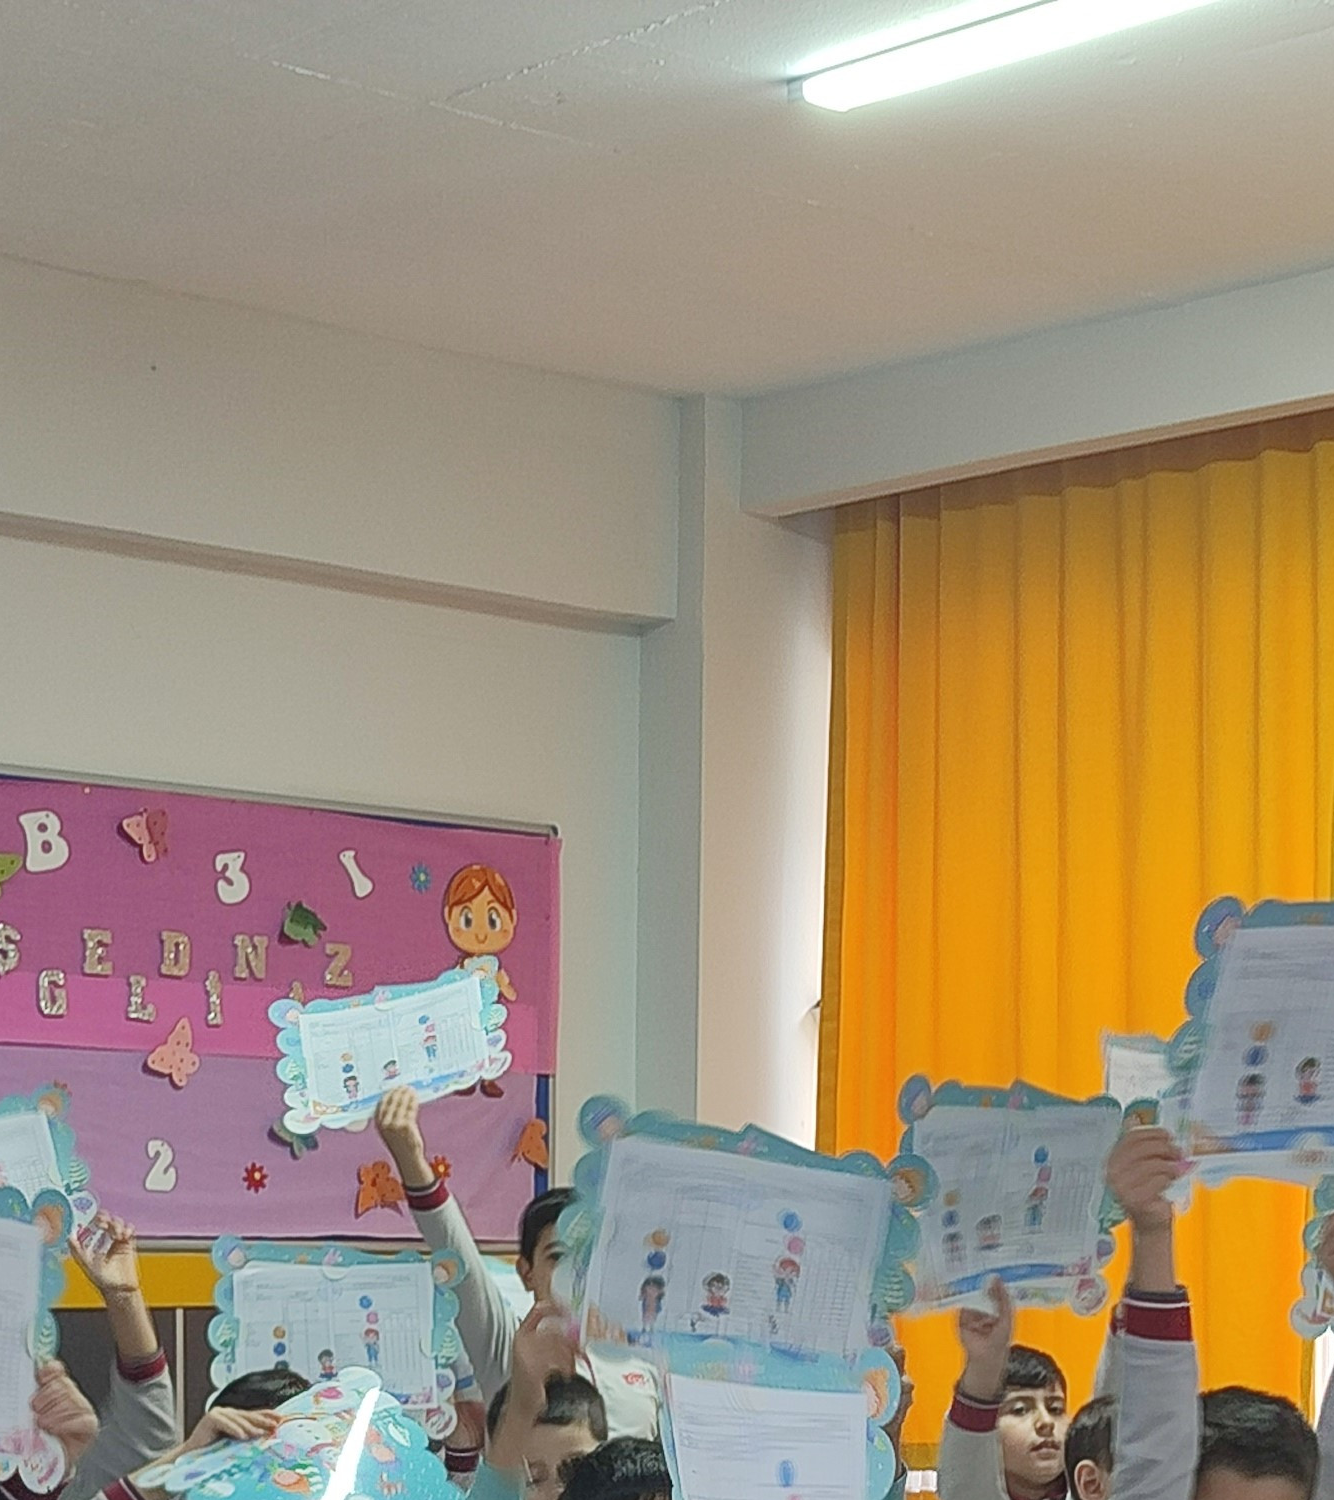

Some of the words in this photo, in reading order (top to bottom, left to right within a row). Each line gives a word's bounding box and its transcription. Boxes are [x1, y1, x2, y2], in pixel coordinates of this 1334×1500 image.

[18, 809, 71, 874] B
[213, 849, 252, 905] 3
[337, 849, 374, 899] 1
[145, 1139, 179, 1193] 2
